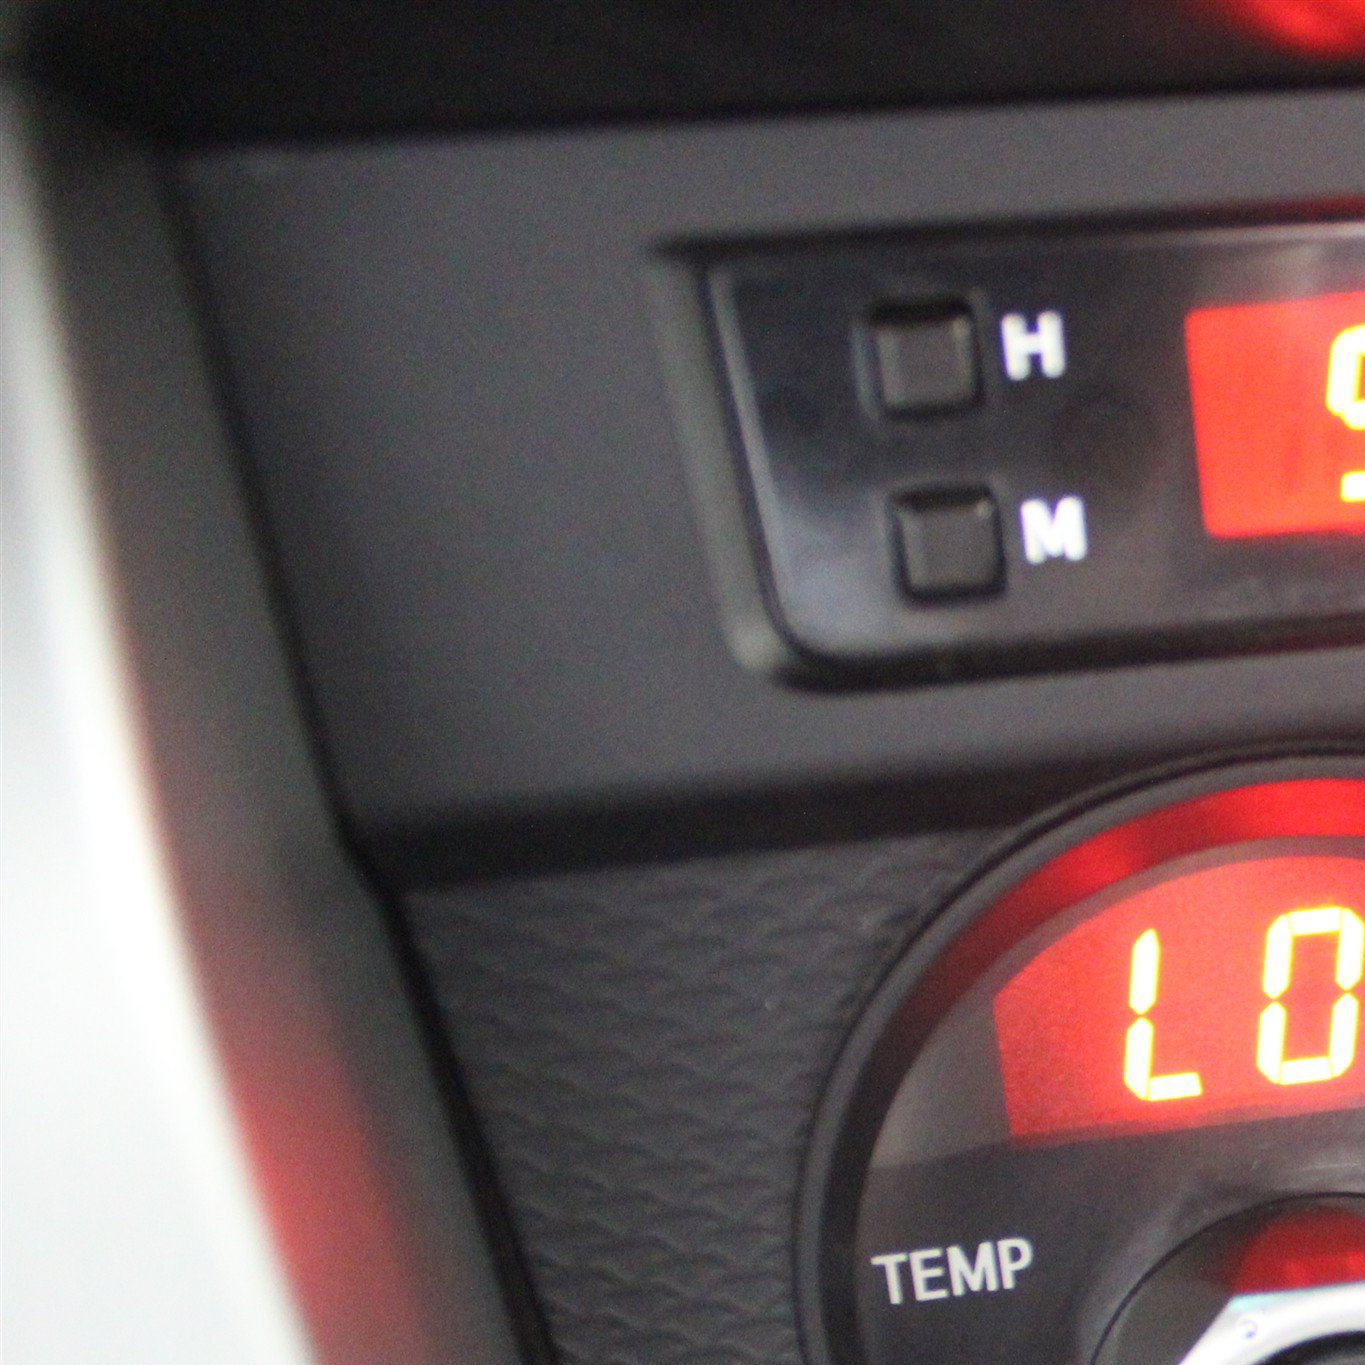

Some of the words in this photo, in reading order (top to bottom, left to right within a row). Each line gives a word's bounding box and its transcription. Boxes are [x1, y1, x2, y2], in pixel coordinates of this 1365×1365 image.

[1000, 310, 1067, 381] H
[1020, 496, 1089, 564] M
[871, 1238, 1034, 1305] TEMP
